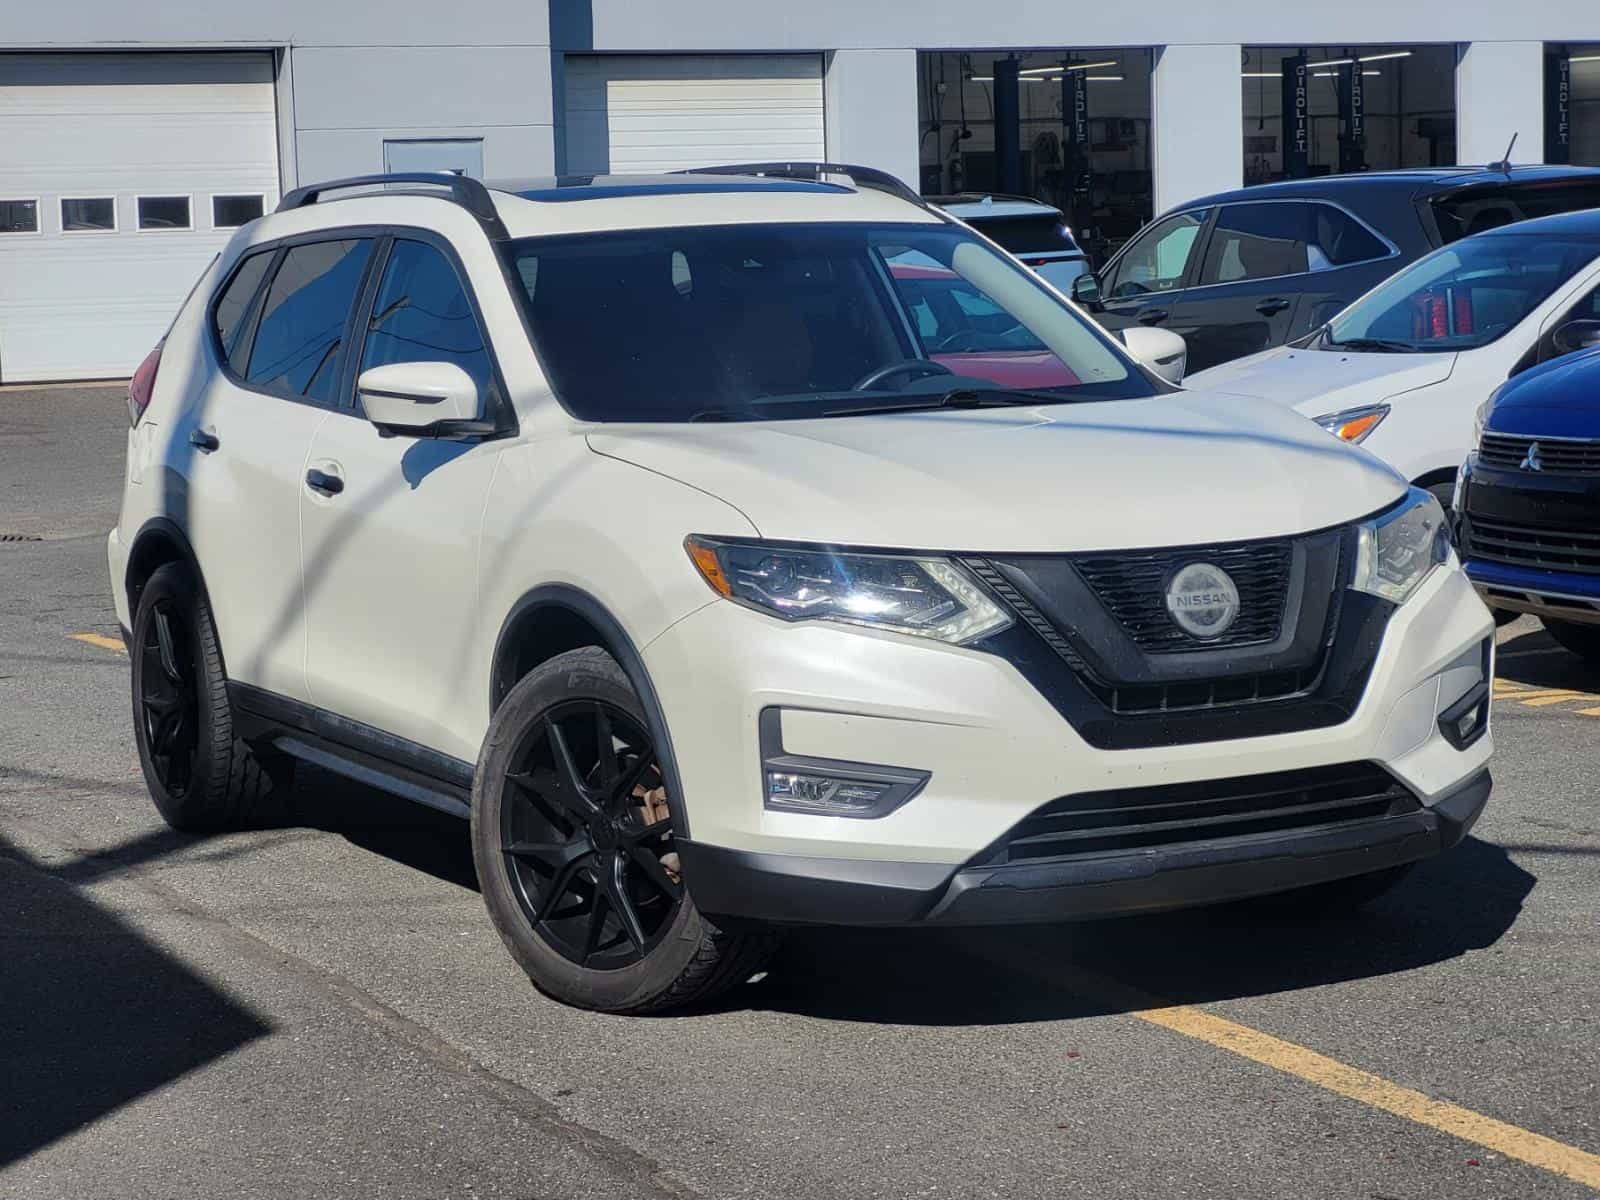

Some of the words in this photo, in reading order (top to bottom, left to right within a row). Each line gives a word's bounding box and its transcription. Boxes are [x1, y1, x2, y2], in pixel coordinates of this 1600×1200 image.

[1296, 65, 1305, 152] GIROLIFT
[1559, 62, 1568, 144] GIROLIFT
[1176, 592, 1232, 607] NISSAN
